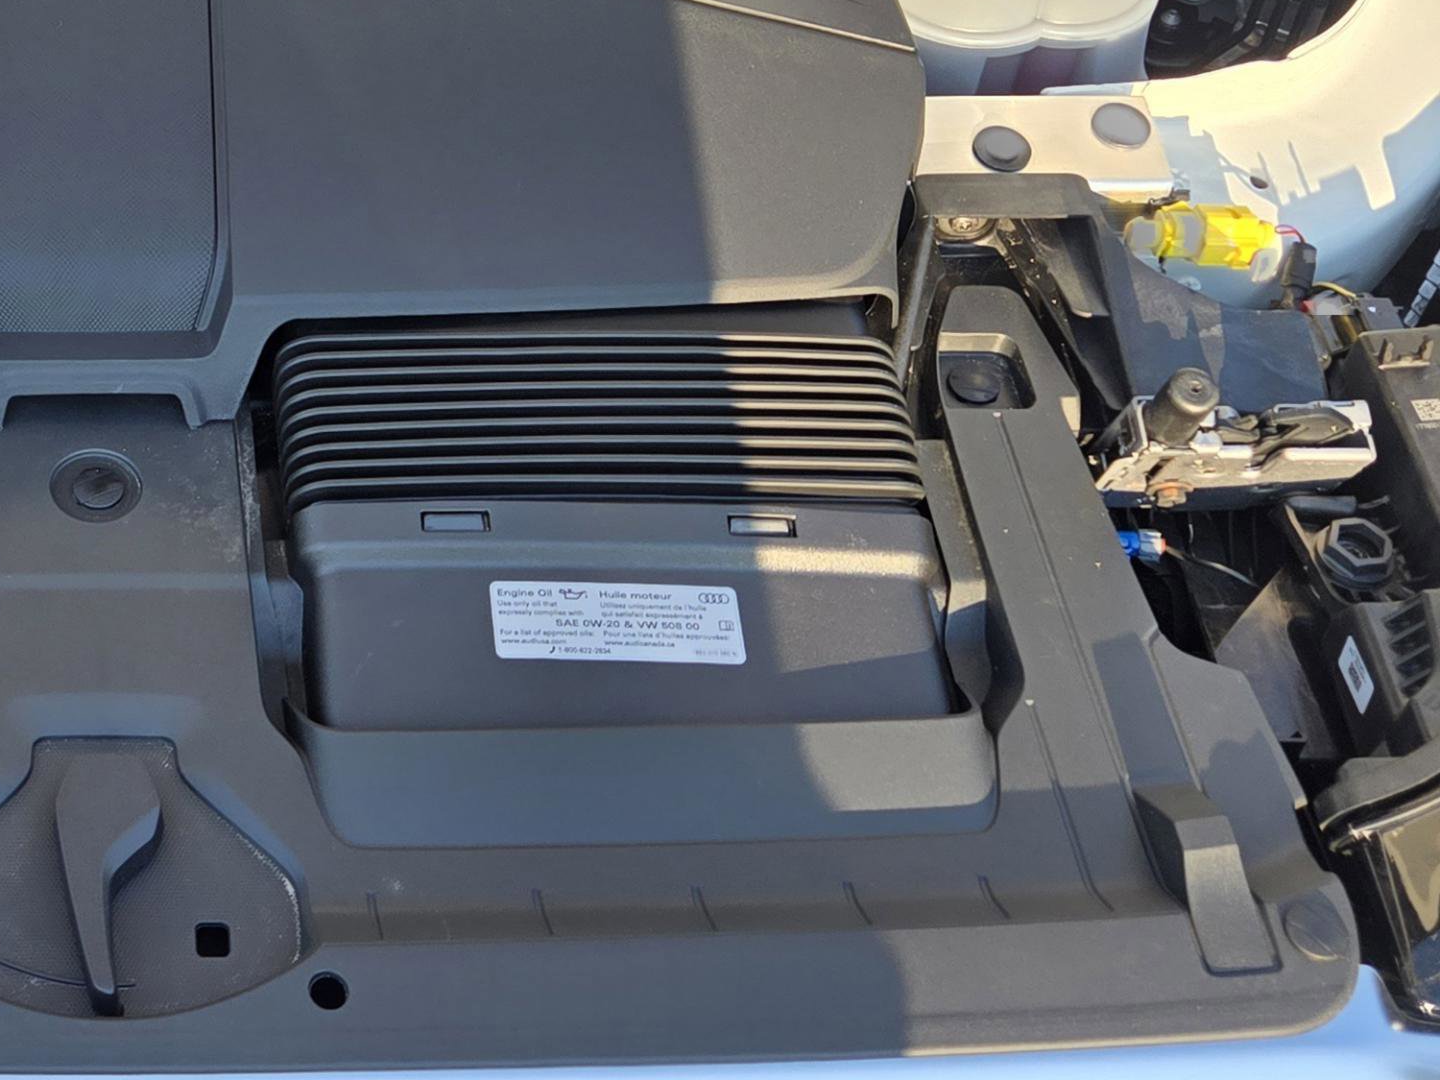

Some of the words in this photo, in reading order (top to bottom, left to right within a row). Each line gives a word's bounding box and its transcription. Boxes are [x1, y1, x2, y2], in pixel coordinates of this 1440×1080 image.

[497, 588, 535, 598] Engine
[537, 588, 553, 597] Oil
[599, 591, 627, 599] Huile
[630, 592, 672, 600] moteur
[556, 619, 579, 627] SAE
[583, 619, 620, 628] 0W-20
[624, 620, 633, 628] &
[636, 621, 658, 629] VW
[661, 622, 683, 630] 508
[685, 622, 700, 631] 00
